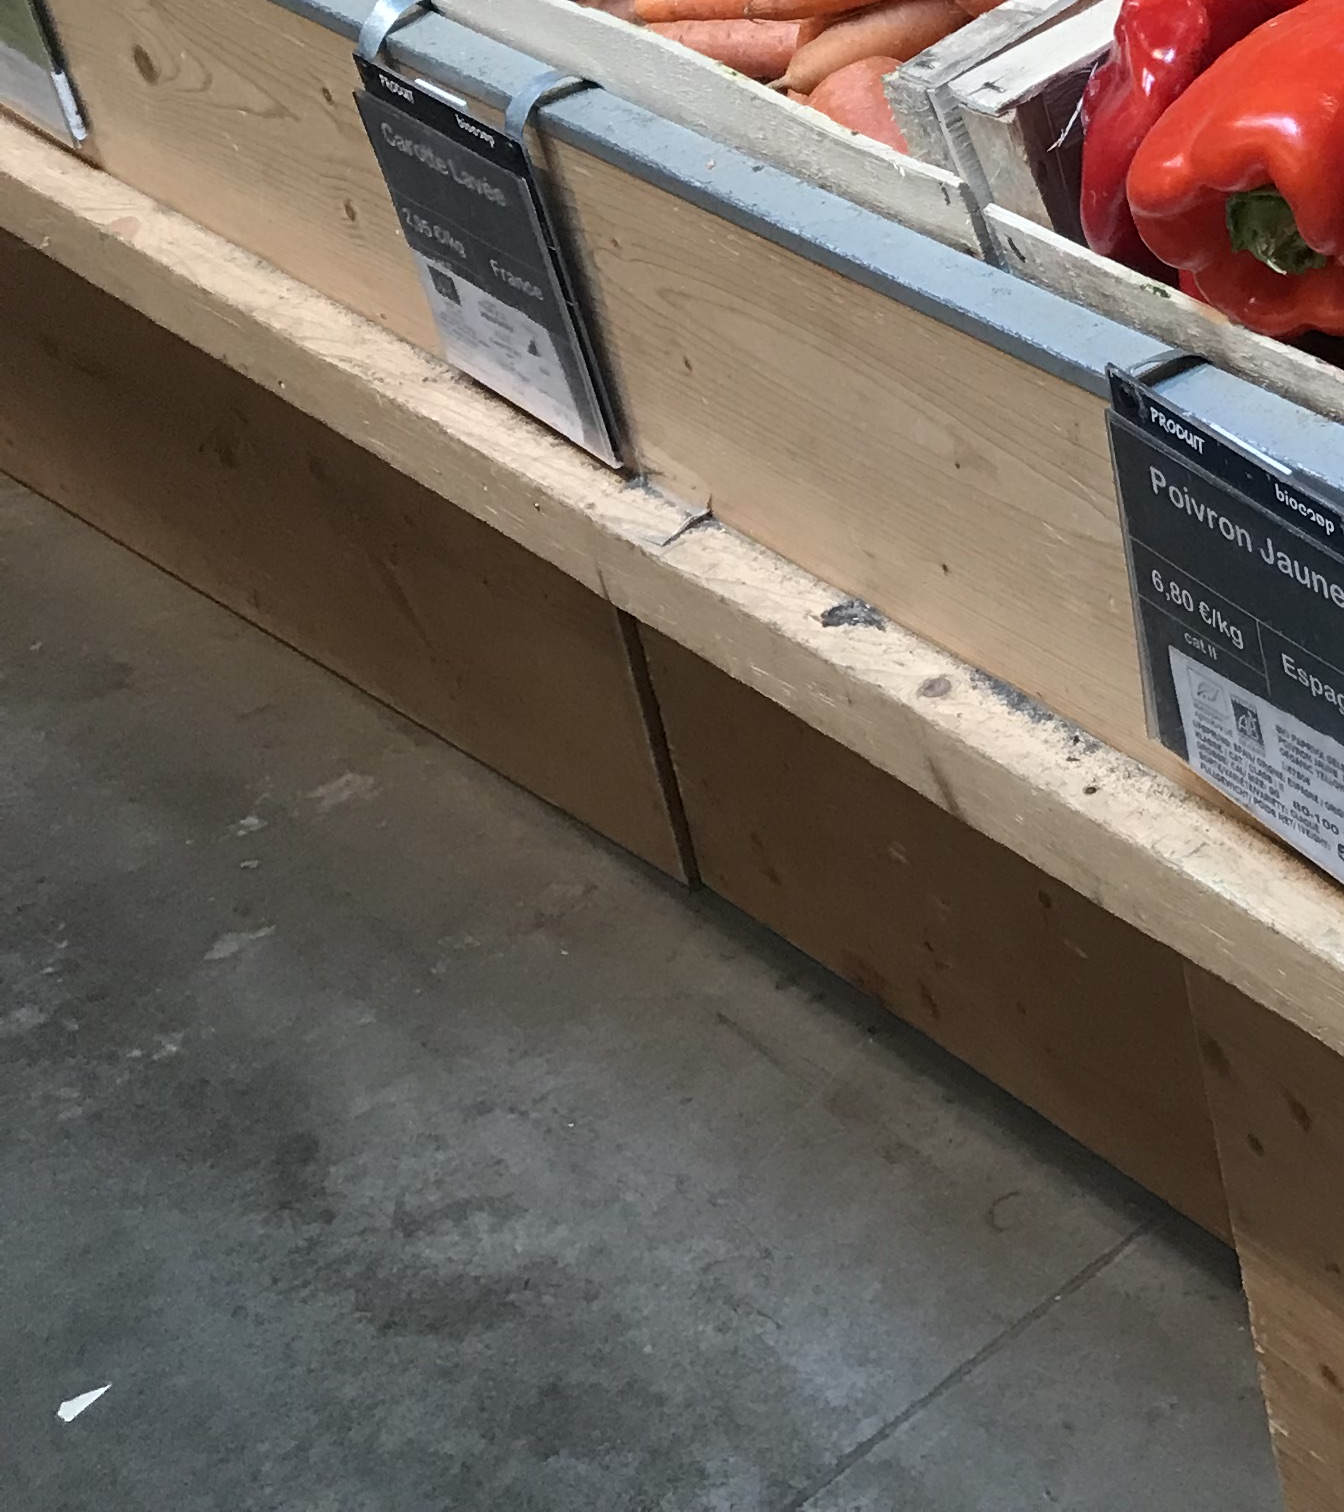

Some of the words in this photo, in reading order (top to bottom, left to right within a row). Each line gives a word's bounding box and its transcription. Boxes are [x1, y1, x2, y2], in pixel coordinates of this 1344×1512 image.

[380, 122, 449, 175] Carotte
[489, 259, 544, 301] France
[1150, 406, 1206, 455] PRODUIT
[1275, 483, 1335, 535] biocoop
[1150, 466, 1253, 552] Poivron
[1151, 569, 1194, 613] 6,80
[1199, 601, 1244, 650] €/kg
[1184, 632, 1207, 654] cat
[1292, 797, 1340, 837] 80-100
